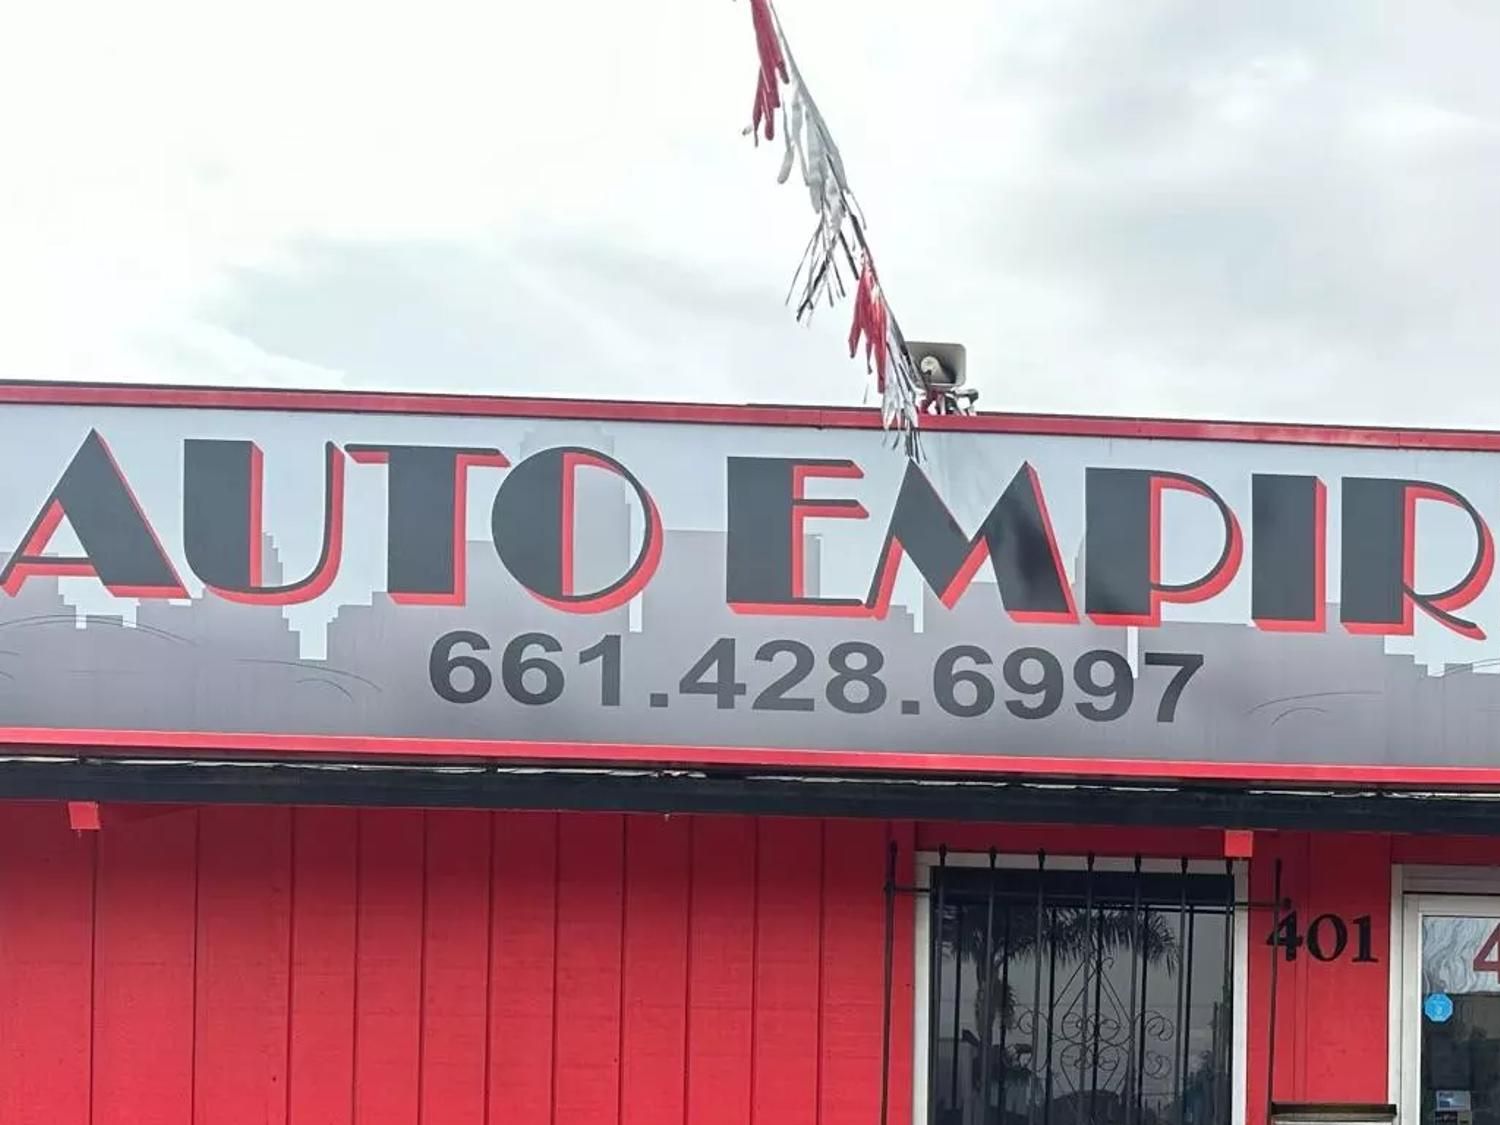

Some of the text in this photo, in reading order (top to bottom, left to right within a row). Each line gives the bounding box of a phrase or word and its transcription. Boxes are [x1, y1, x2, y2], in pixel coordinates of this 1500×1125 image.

[0, 426, 664, 614] AUTO
[428, 630, 1205, 724] 661.428.6997
[1266, 910, 1379, 963] 401
